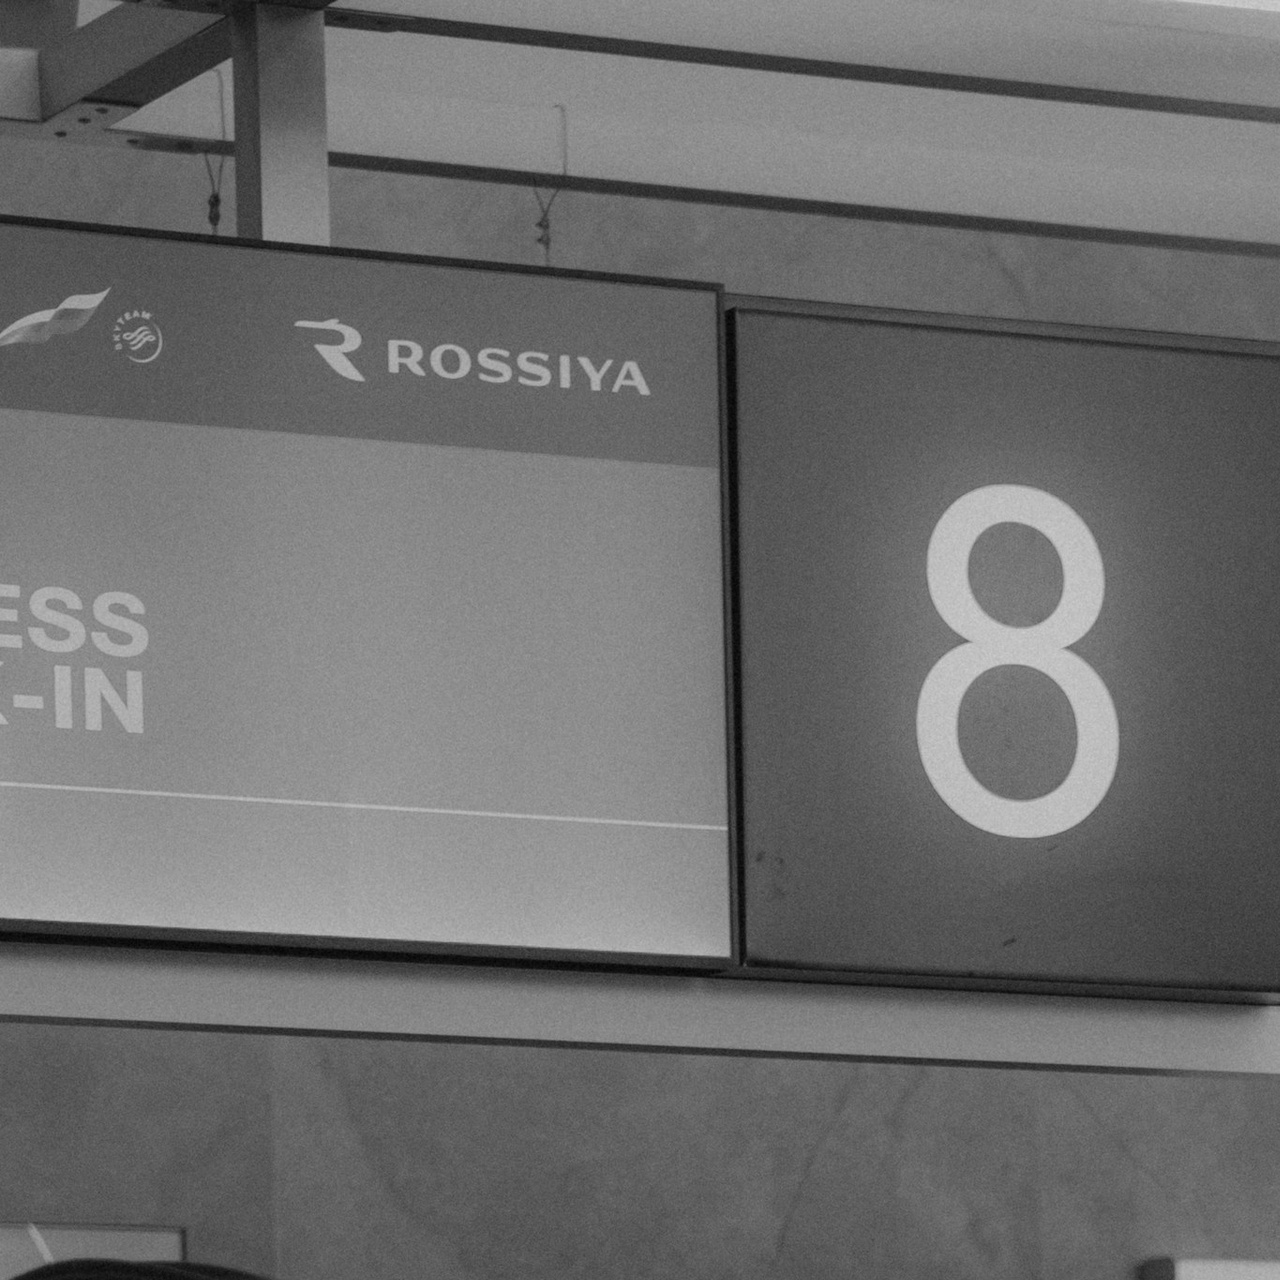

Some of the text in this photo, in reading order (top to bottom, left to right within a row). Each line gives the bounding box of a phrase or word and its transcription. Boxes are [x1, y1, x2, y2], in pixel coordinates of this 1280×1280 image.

[387, 340, 651, 395] ROSSIYA
[0, 661, 144, 734] -IN
[916, 484, 1120, 838] 8
